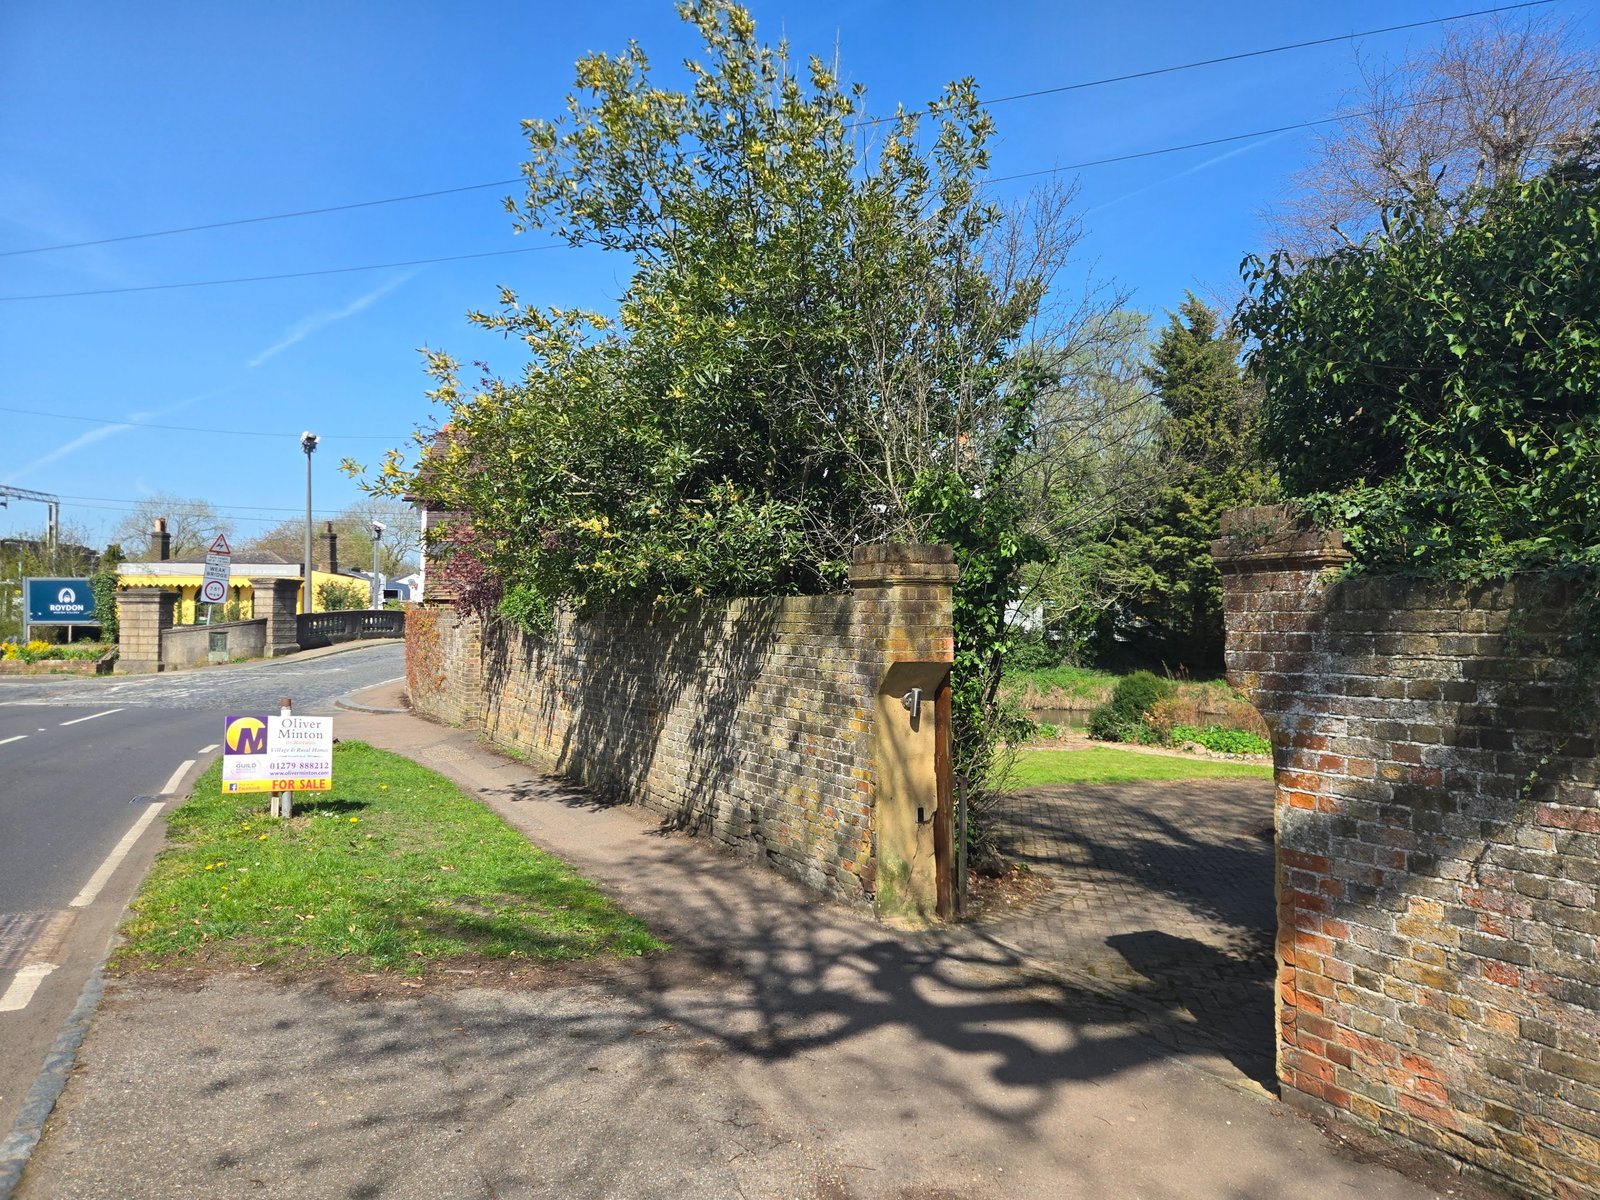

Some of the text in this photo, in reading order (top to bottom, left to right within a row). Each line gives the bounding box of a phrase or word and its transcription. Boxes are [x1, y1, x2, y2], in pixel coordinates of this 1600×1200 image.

[206, 571, 228, 579] BRIDGE
[281, 718, 322, 729] Oliver
[278, 729, 323, 739] Minton
[270, 762, 329, 770] 01279 888212
[272, 778, 326, 790] FOR SALE
